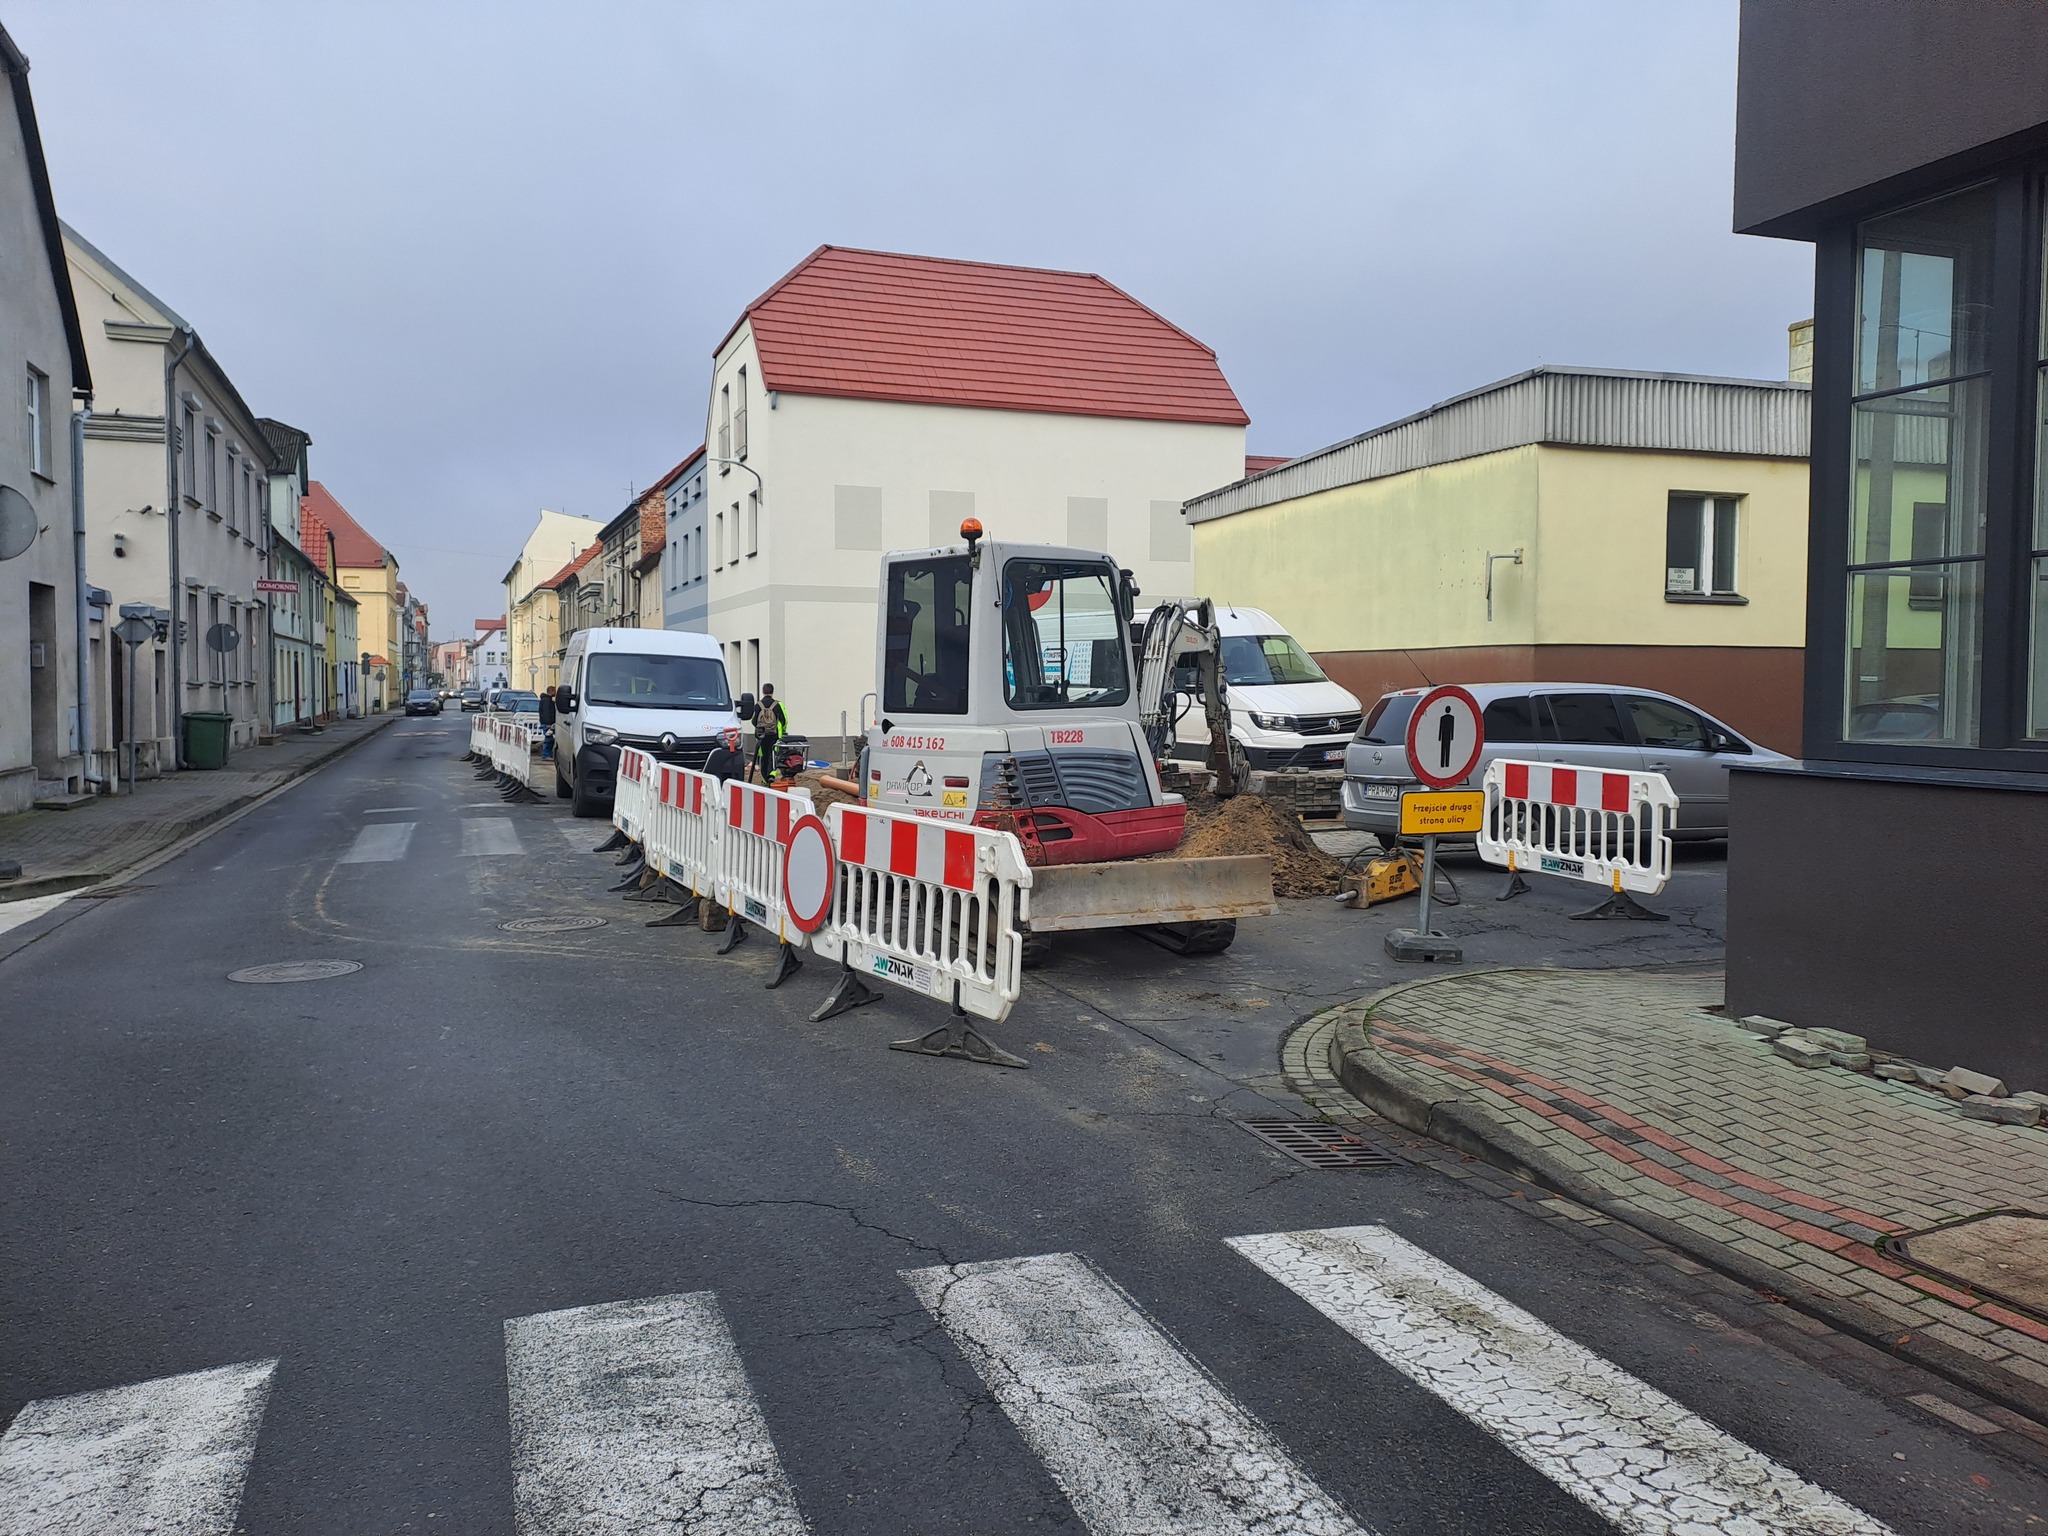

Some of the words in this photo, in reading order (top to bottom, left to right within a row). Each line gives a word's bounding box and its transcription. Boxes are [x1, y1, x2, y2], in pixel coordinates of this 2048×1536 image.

[257, 582, 298, 590] KOMORNIK
[890, 735, 905, 748] 608
[906, 736, 923, 749] 415
[926, 737, 945, 750] 162
[1050, 730, 1084, 744] TB228
[1368, 784, 1380, 796] PRA
[1419, 817, 1444, 826] stroną
[1447, 815, 1465, 825] ulicy
